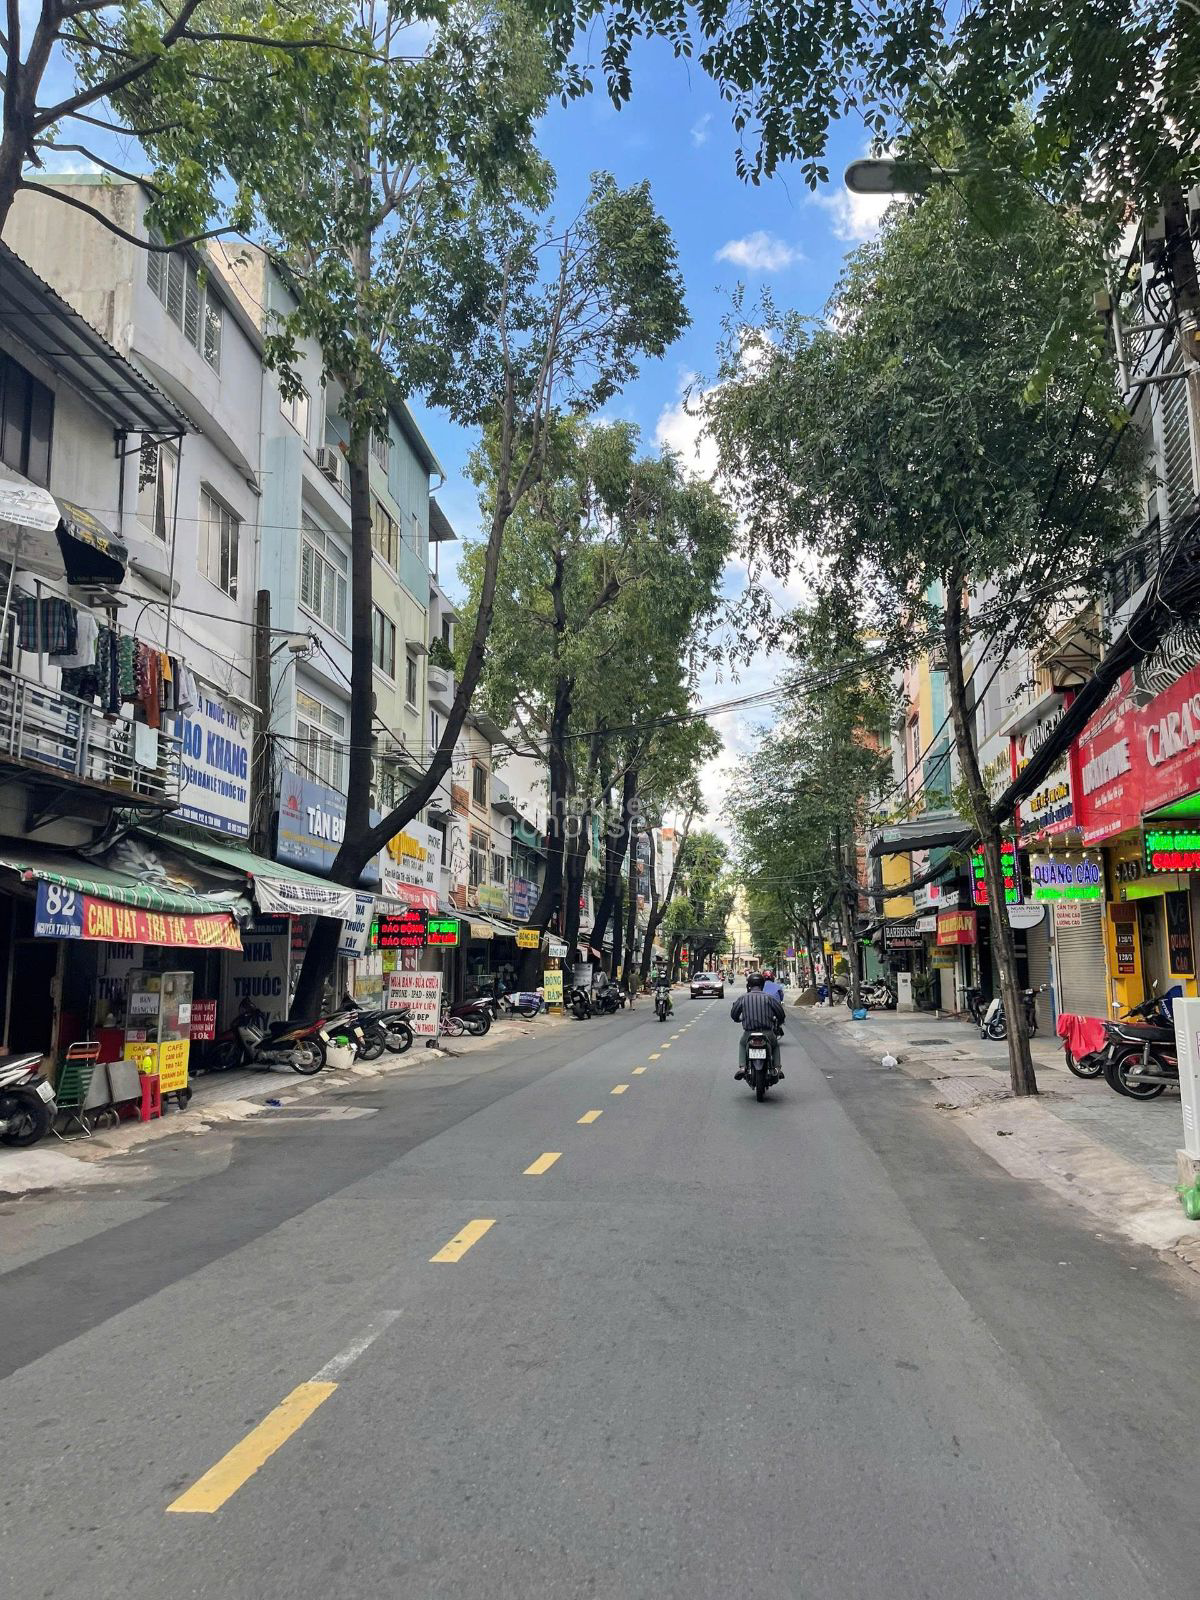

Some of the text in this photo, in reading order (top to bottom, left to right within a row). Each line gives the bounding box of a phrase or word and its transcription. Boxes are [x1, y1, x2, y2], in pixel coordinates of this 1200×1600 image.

[206, 729, 248, 780] KHANG
[306, 804, 331, 840] TÂN
[1034, 858, 1072, 886] QUẢNG
[46, 884, 76, 916] 82
[36, 918, 56, 934] NGUYỄN
[56, 922, 70, 936] THÁI
[88, 904, 114, 936] CAM
[344, 919, 365, 933] THUỐC
[382, 922, 399, 933] BÁO
[346, 936, 358, 949] TÂY
[382, 935, 399, 945] BÁO
[234, 970, 282, 996] THUỐC
